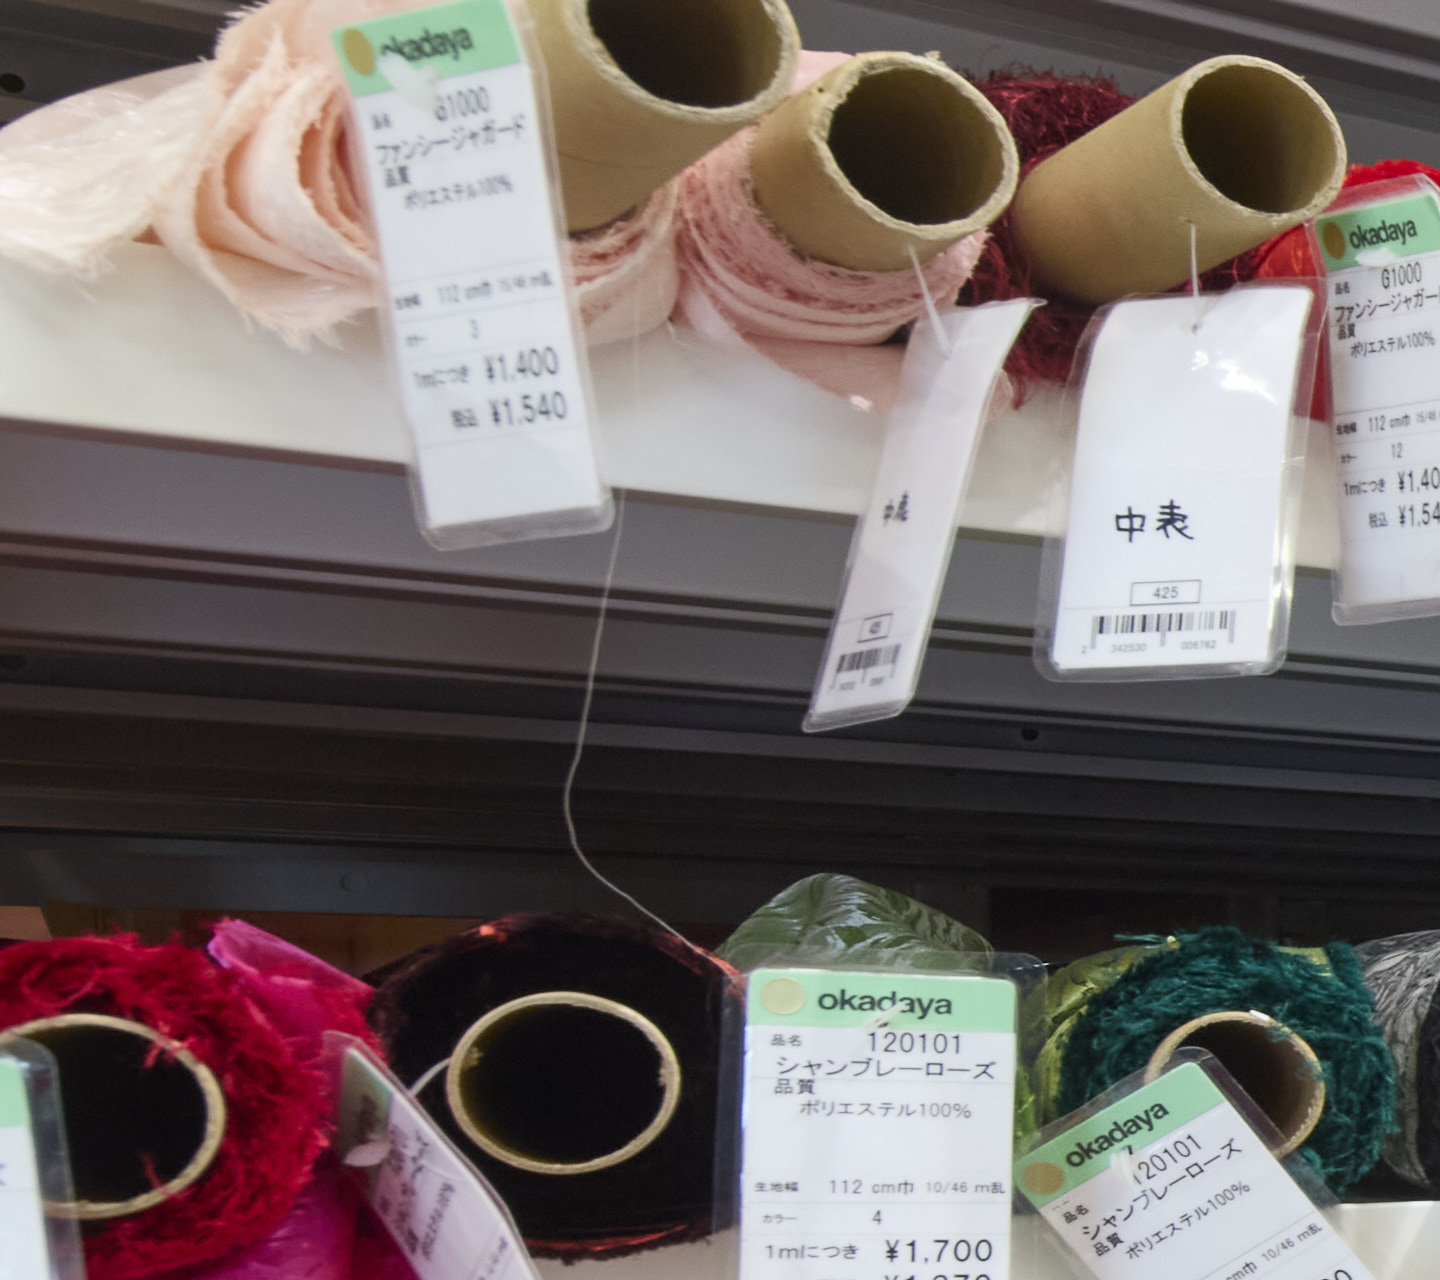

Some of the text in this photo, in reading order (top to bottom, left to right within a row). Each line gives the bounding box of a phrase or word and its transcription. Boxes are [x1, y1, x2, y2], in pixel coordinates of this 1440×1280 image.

[1348, 217, 1418, 248] okadaya
[1381, 262, 1422, 289] G1000
[1349, 331, 1436, 358] ポリエステル100%
[485, 346, 559, 384] ¥1,400
[490, 391, 568, 428] ¥1,540
[1115, 500, 1196, 542] 中表
[1152, 586, 1179, 599] 425
[818, 989, 952, 1020] okadaya
[868, 1032, 961, 1054] 120101
[776, 1057, 996, 1081] シャンブレーローズ
[799, 1100, 971, 1119] ポリエステル100%
[1065, 1099, 1169, 1170] okadaya
[830, 1180, 967, 1194] 112 10/46
[1081, 1138, 1243, 1241] シャンブレーローズ
[1125, 1179, 1251, 1262] ポリエステル100%
[884, 1239, 992, 1264] ¥1,700
